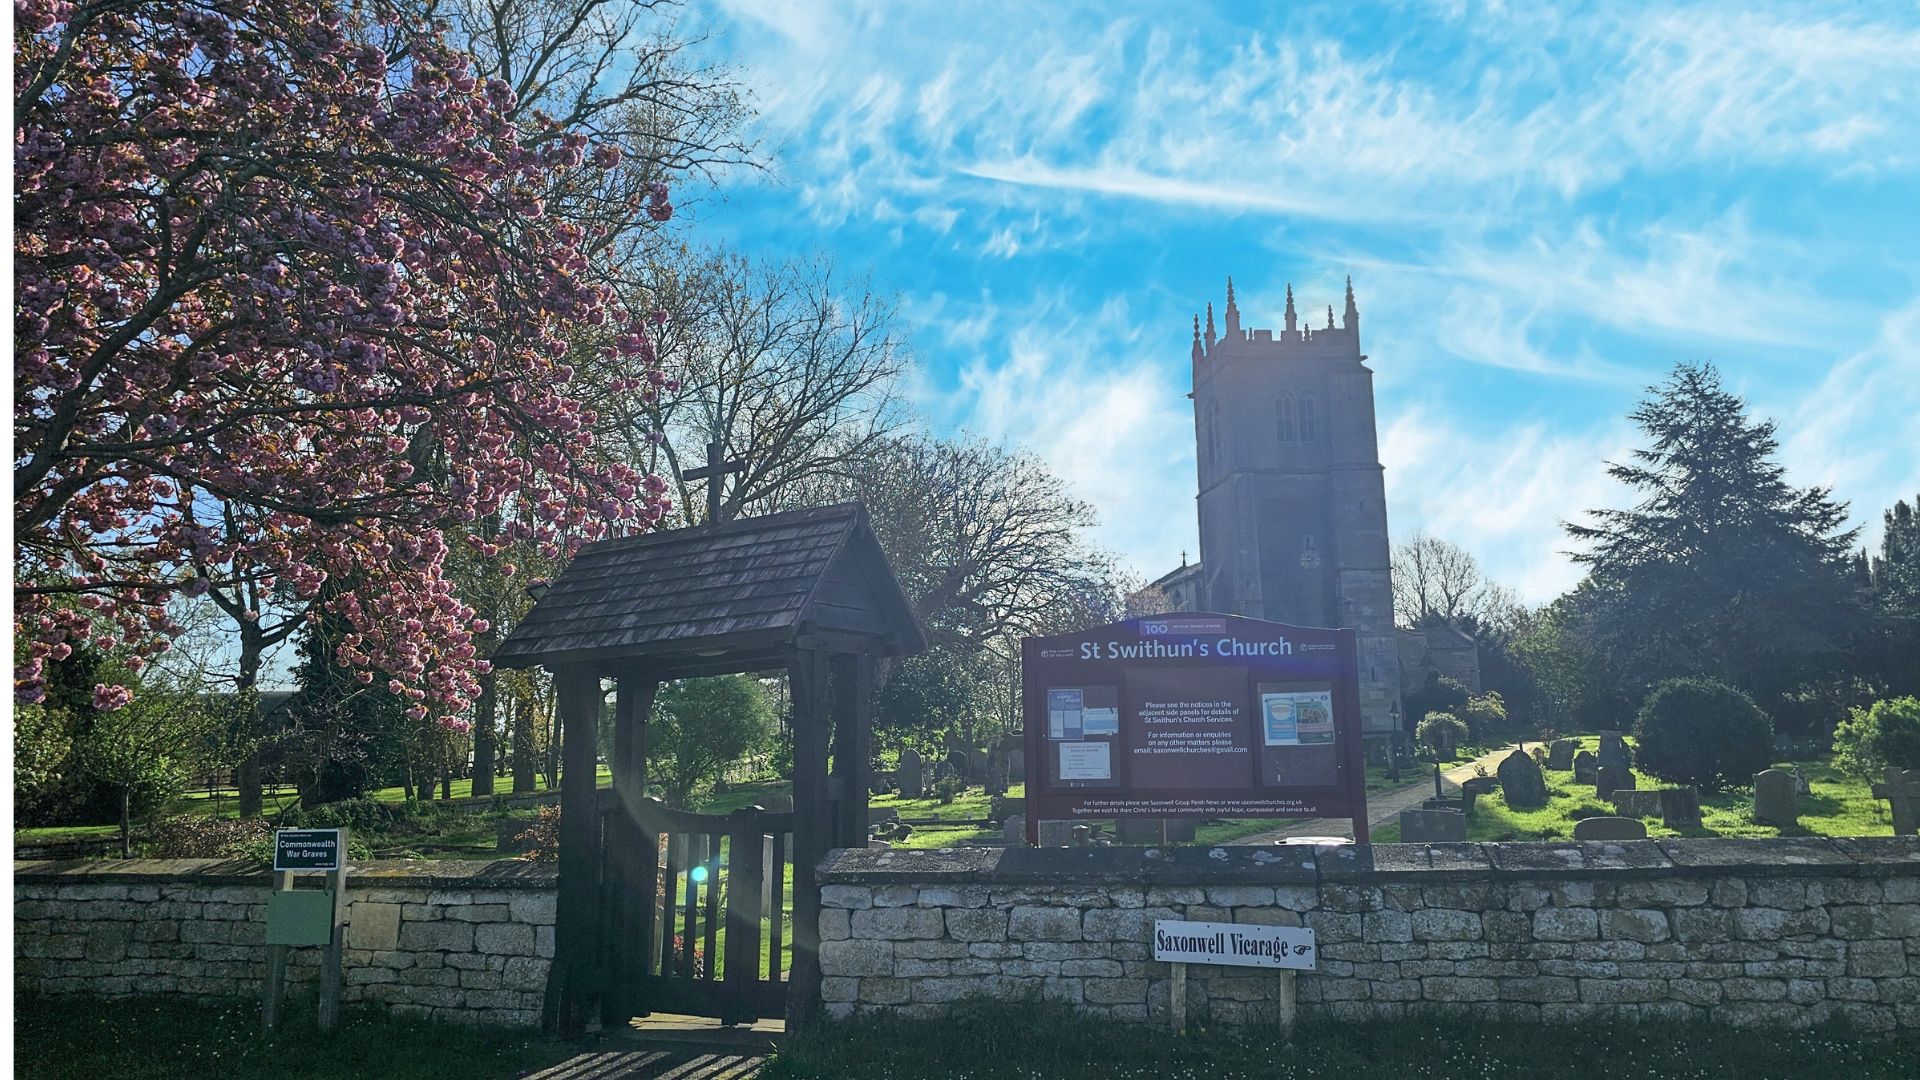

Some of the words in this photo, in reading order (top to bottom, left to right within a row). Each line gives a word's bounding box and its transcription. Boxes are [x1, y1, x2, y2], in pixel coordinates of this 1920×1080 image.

[1080, 642, 1100, 660] St
[1108, 639, 1209, 659] Swithun's
[1216, 636, 1292, 656] Church
[1157, 930, 1225, 954] Saxonwell
[1231, 933, 1288, 963] Vicarage
